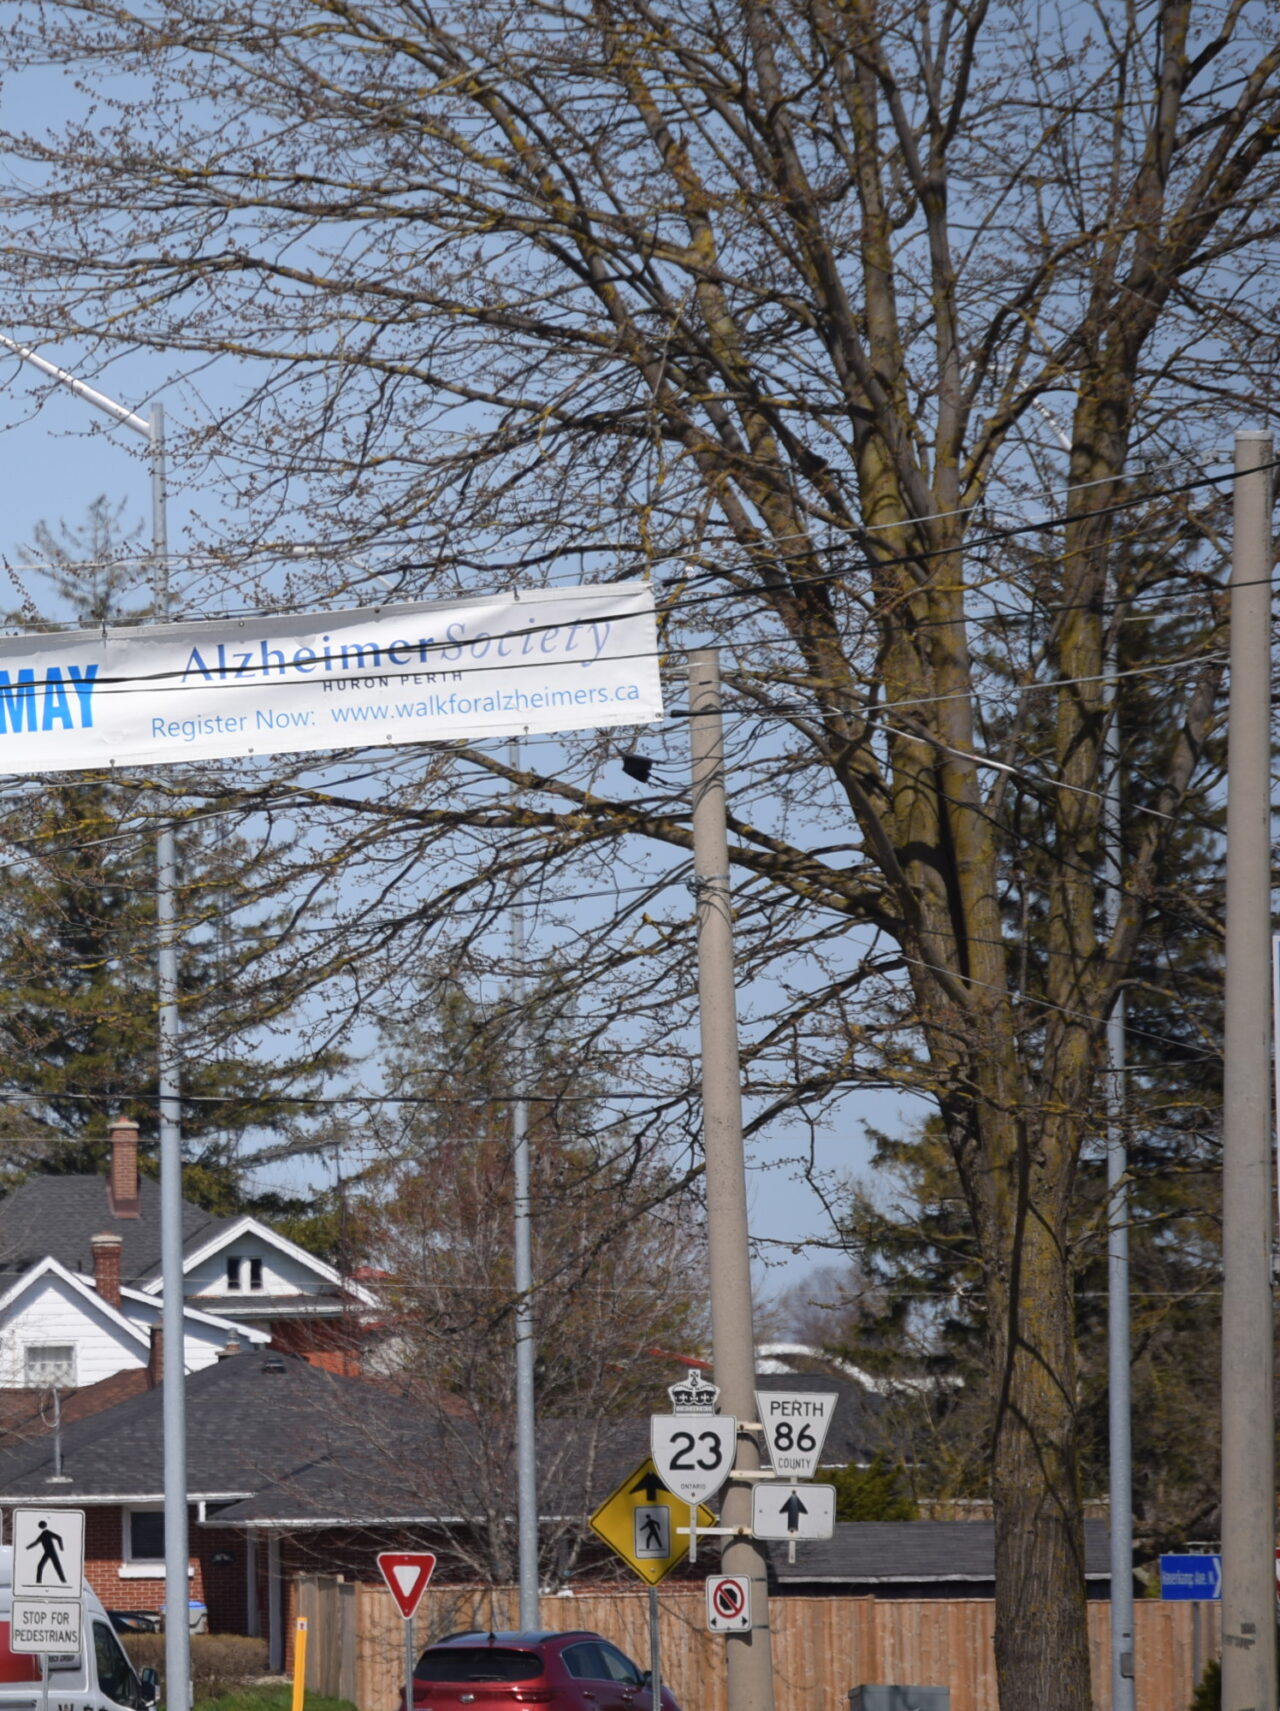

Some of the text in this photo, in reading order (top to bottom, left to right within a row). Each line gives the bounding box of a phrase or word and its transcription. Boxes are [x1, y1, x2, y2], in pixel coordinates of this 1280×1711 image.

[323, 671, 463, 692] HURON PERTH
[152, 682, 640, 742] Register Now: www.walkforalzheimers.ca
[770, 1401, 824, 1417] PERTH
[774, 1422, 817, 1452] 86
[669, 1431, 723, 1471] 23
[778, 1457, 811, 1469] COUNTY
[23, 1611, 70, 1626] STOP FOR
[15, 1629, 78, 1643] PEDESTRIANS
